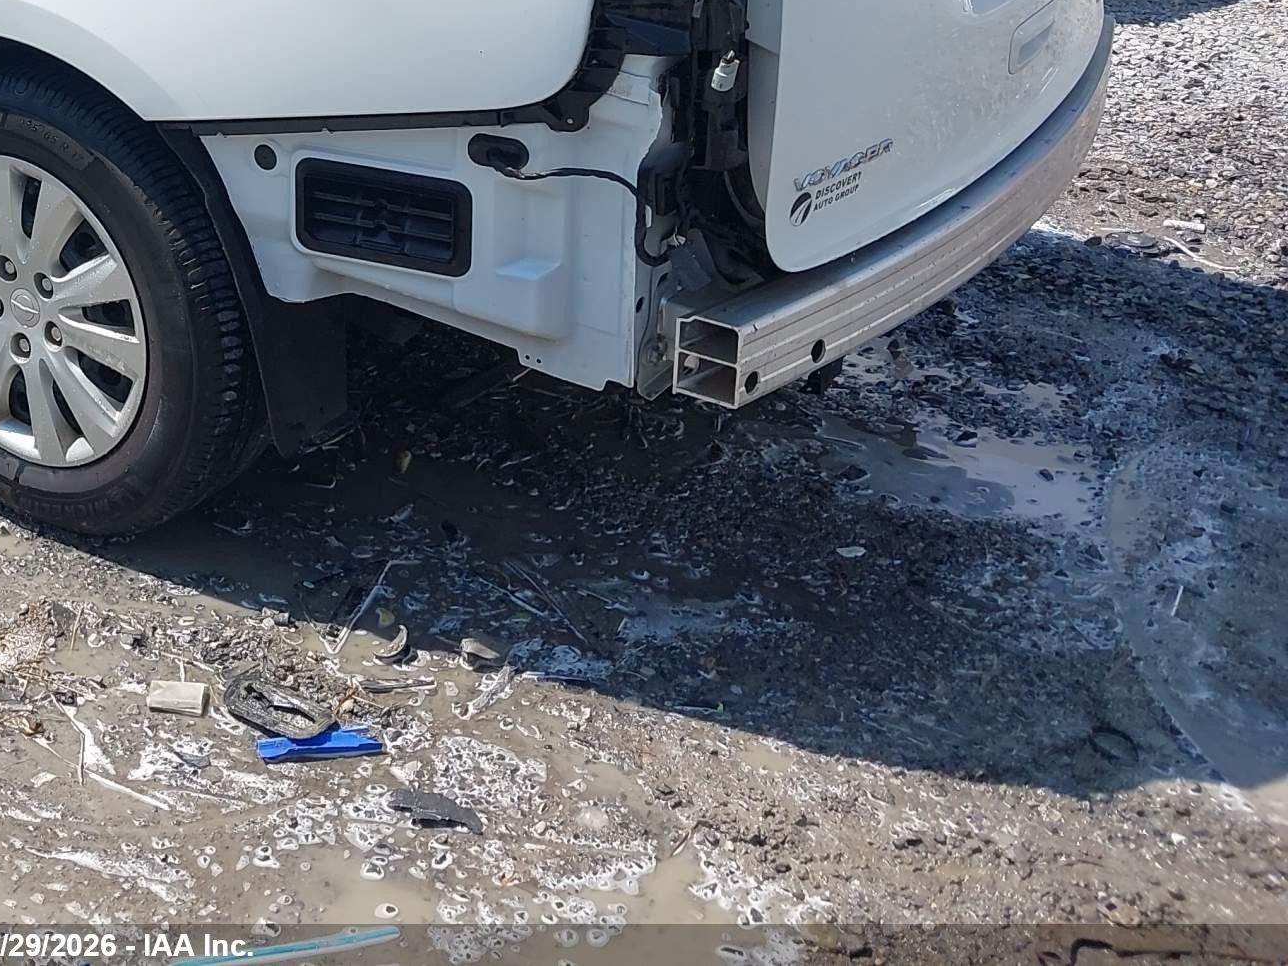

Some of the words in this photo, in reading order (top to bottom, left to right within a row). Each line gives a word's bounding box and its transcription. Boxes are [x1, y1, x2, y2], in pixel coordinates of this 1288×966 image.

[793, 138, 893, 191] VOYAGER
[813, 197, 833, 211] AUTO
[834, 184, 859, 202] GROUP
[815, 171, 862, 200] DISCOVERY
